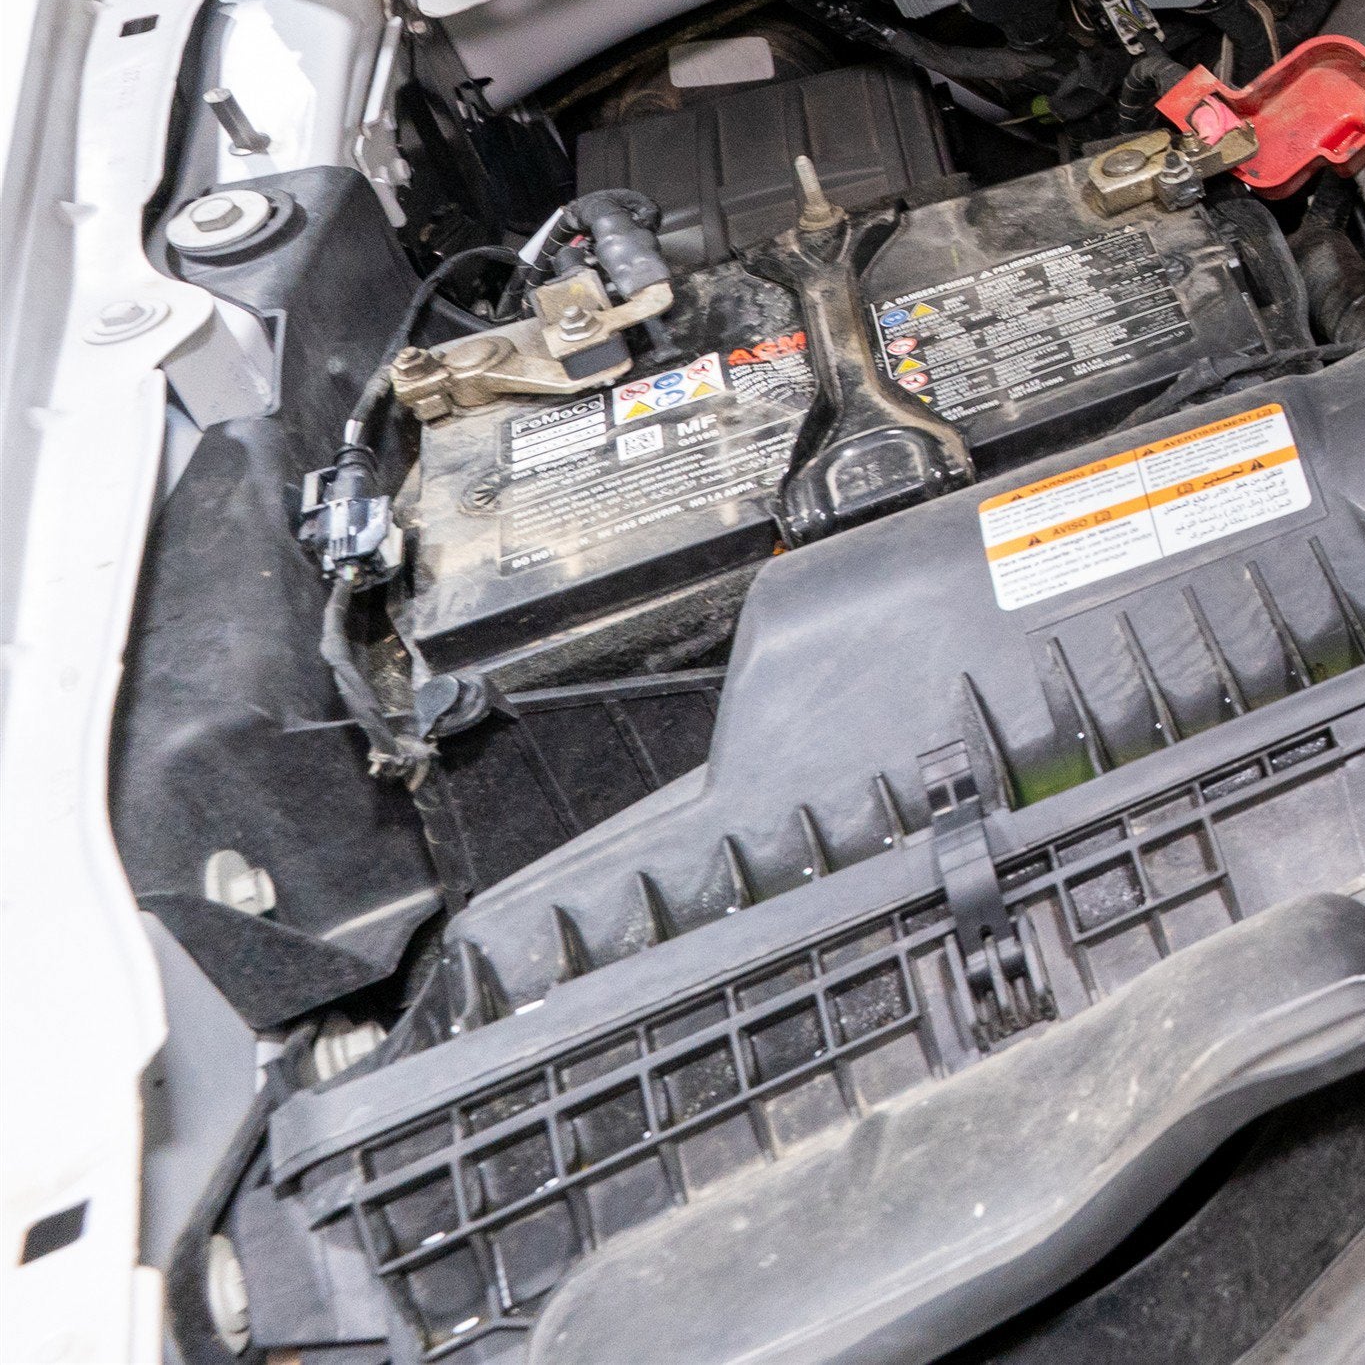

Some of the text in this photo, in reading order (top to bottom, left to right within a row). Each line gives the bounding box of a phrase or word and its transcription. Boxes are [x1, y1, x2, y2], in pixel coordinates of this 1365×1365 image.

[516, 400, 601, 434] FoMoCo
[676, 413, 717, 436] MF
[1052, 519, 1088, 536] AVISO
